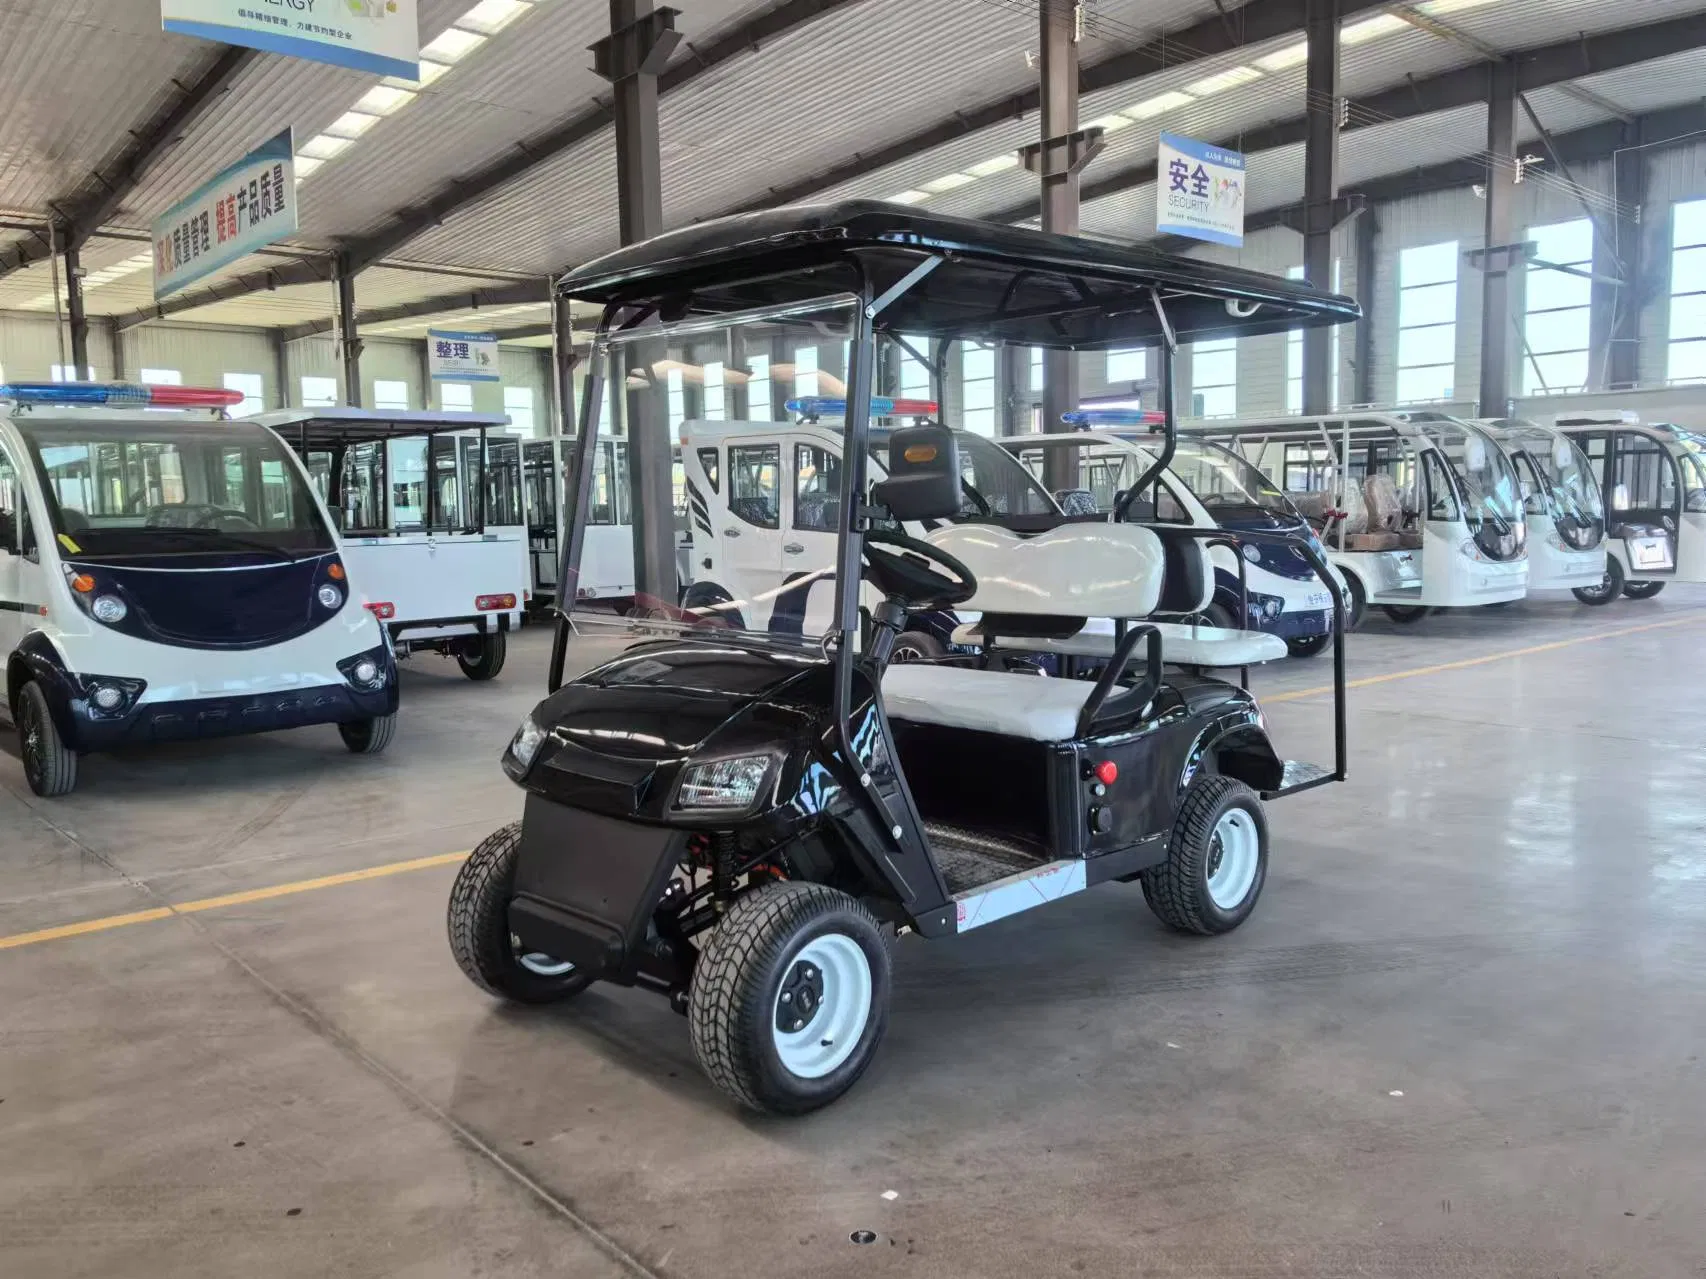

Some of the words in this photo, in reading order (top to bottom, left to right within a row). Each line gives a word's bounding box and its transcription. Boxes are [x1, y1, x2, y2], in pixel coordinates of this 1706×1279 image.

[1168, 158, 1210, 198] 安全
[215, 163, 285, 244] 提高产品质量
[1168, 194, 1210, 213] SECURITY
[436, 340, 470, 359] 整理
